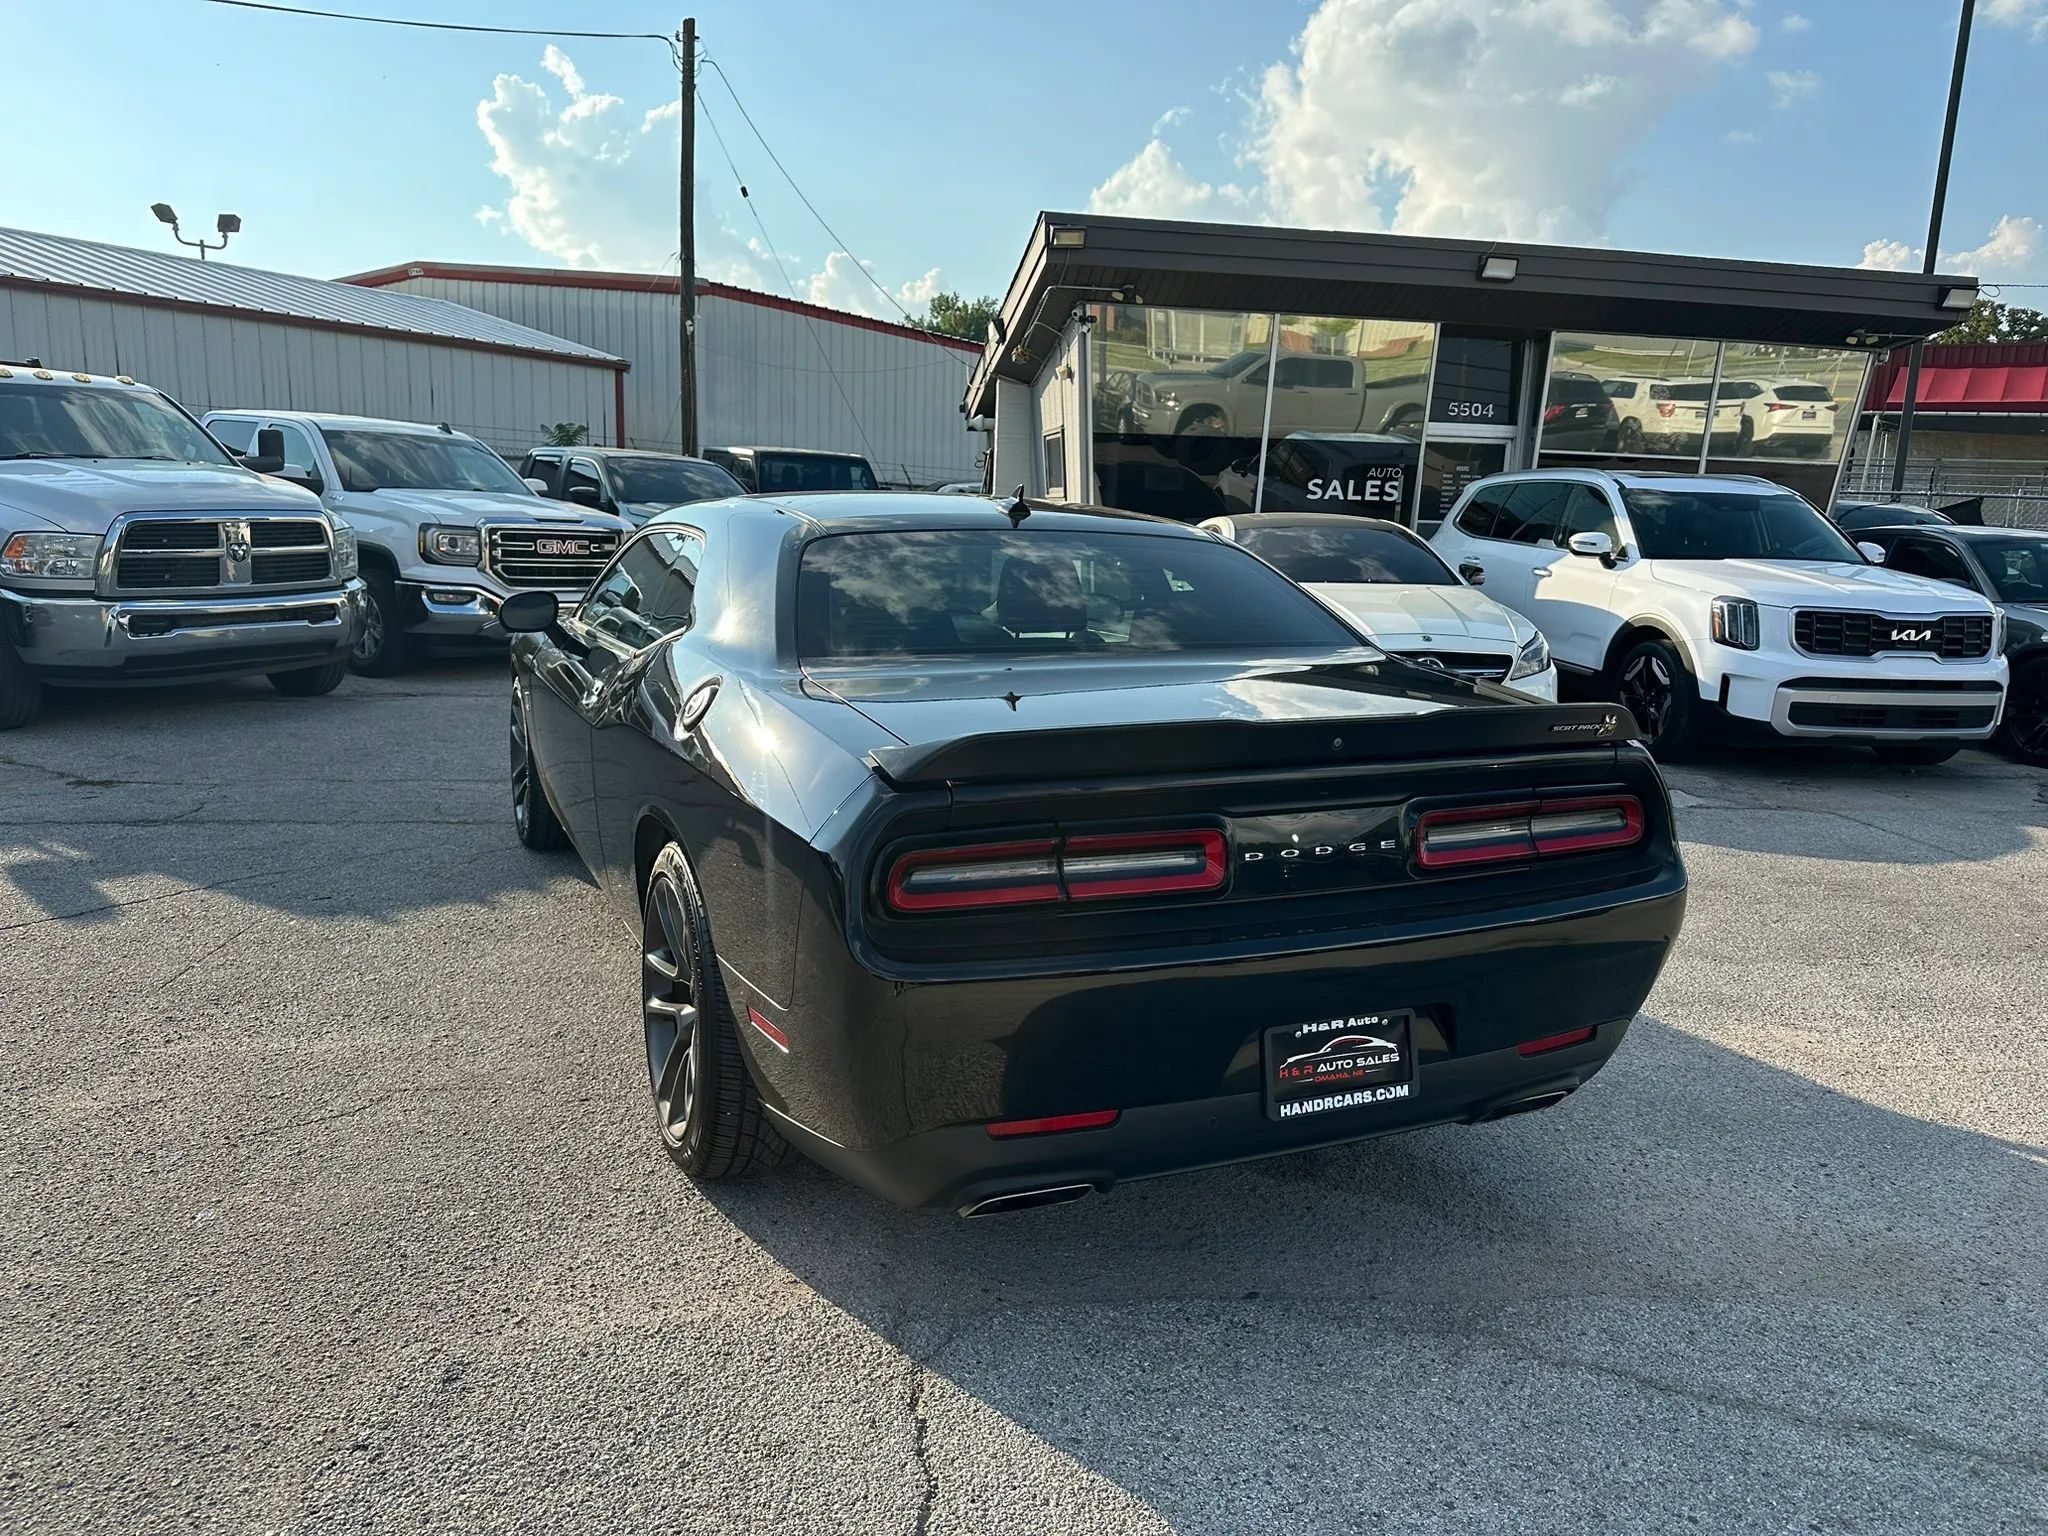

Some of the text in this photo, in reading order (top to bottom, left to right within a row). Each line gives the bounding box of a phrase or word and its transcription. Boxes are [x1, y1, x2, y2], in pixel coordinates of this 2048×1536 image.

[1447, 402, 1494, 418] 5504
[1367, 467, 1403, 478] AUTO
[1306, 478, 1400, 501] SALES
[537, 539, 590, 555] GMC
[1245, 840, 1396, 861] DODGE
[1302, 1016, 1379, 1034] H&R Auto
[1279, 1053, 1400, 1078] H & R AUTO SALES
[1352, 1069, 1365, 1078] NE
[1280, 1084, 1409, 1118] HANDRCARS.COM
